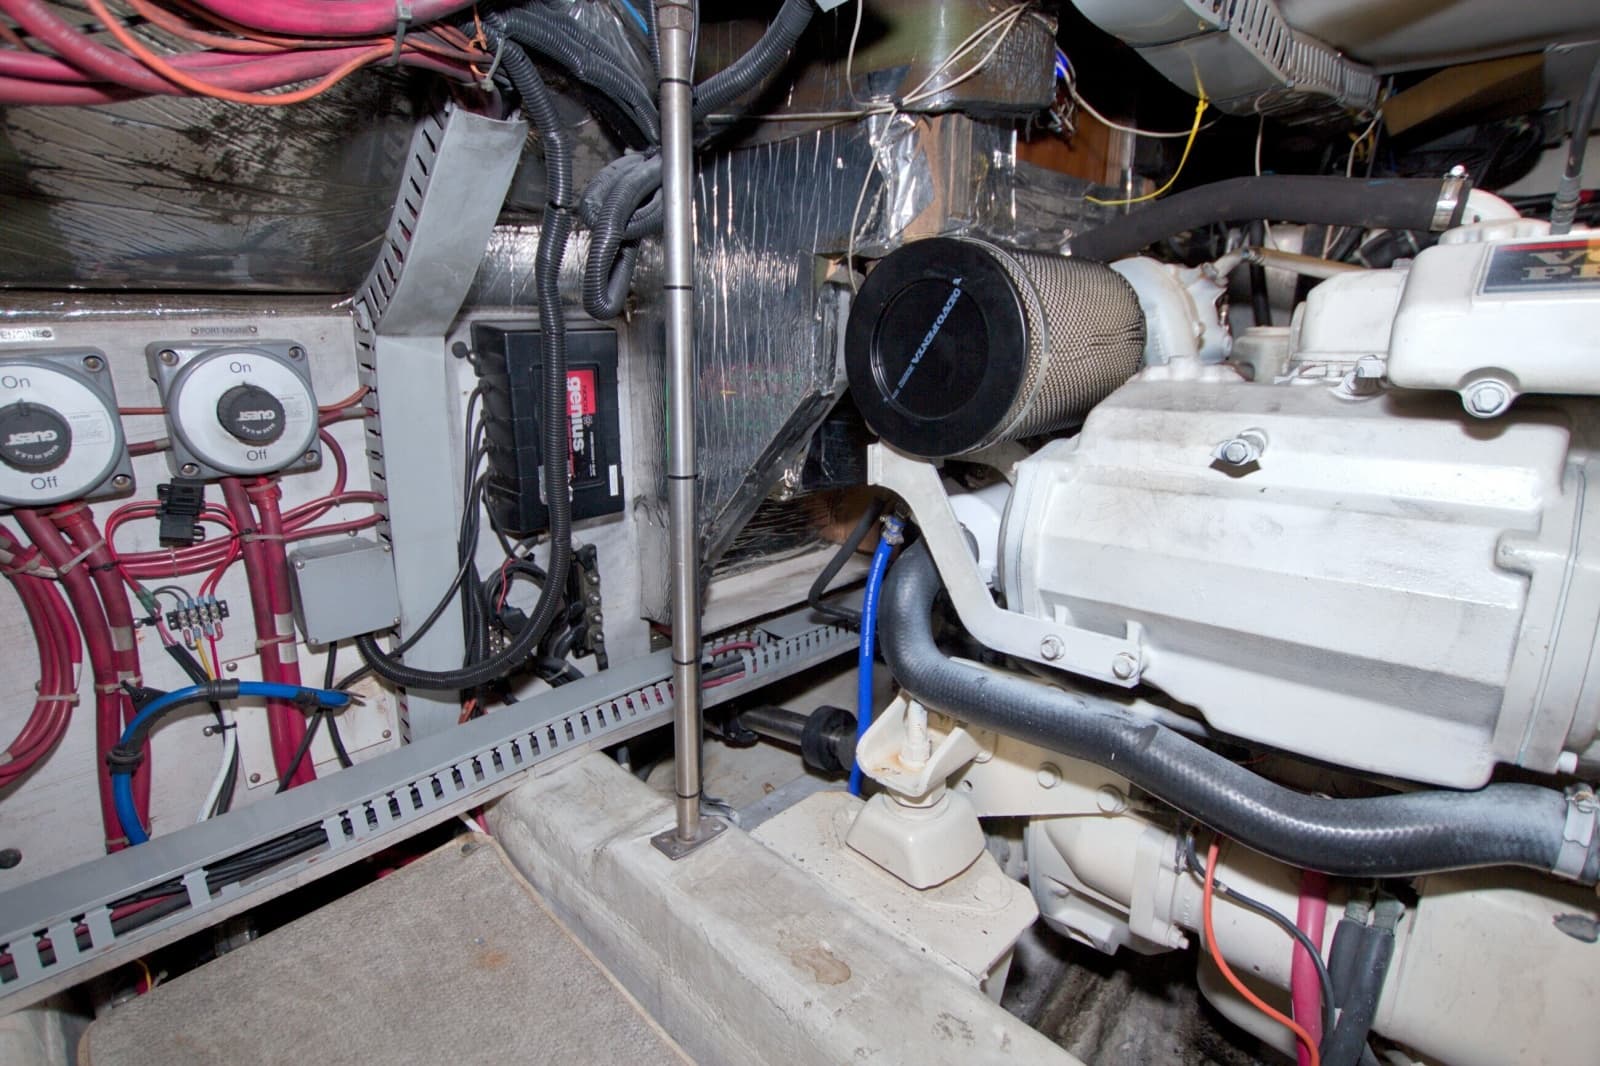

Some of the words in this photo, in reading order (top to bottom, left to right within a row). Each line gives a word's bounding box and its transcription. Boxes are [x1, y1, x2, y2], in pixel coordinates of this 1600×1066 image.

[199, 327, 220, 336] PORT
[910, 321, 940, 364] PENTA
[229, 361, 252, 373] On
[1, 375, 31, 390] On
[236, 409, 276, 422] GUEST
[567, 375, 584, 452] genius
[5, 429, 58, 446] GUEST
[246, 449, 268, 462] Off
[30, 475, 59, 490] Off
